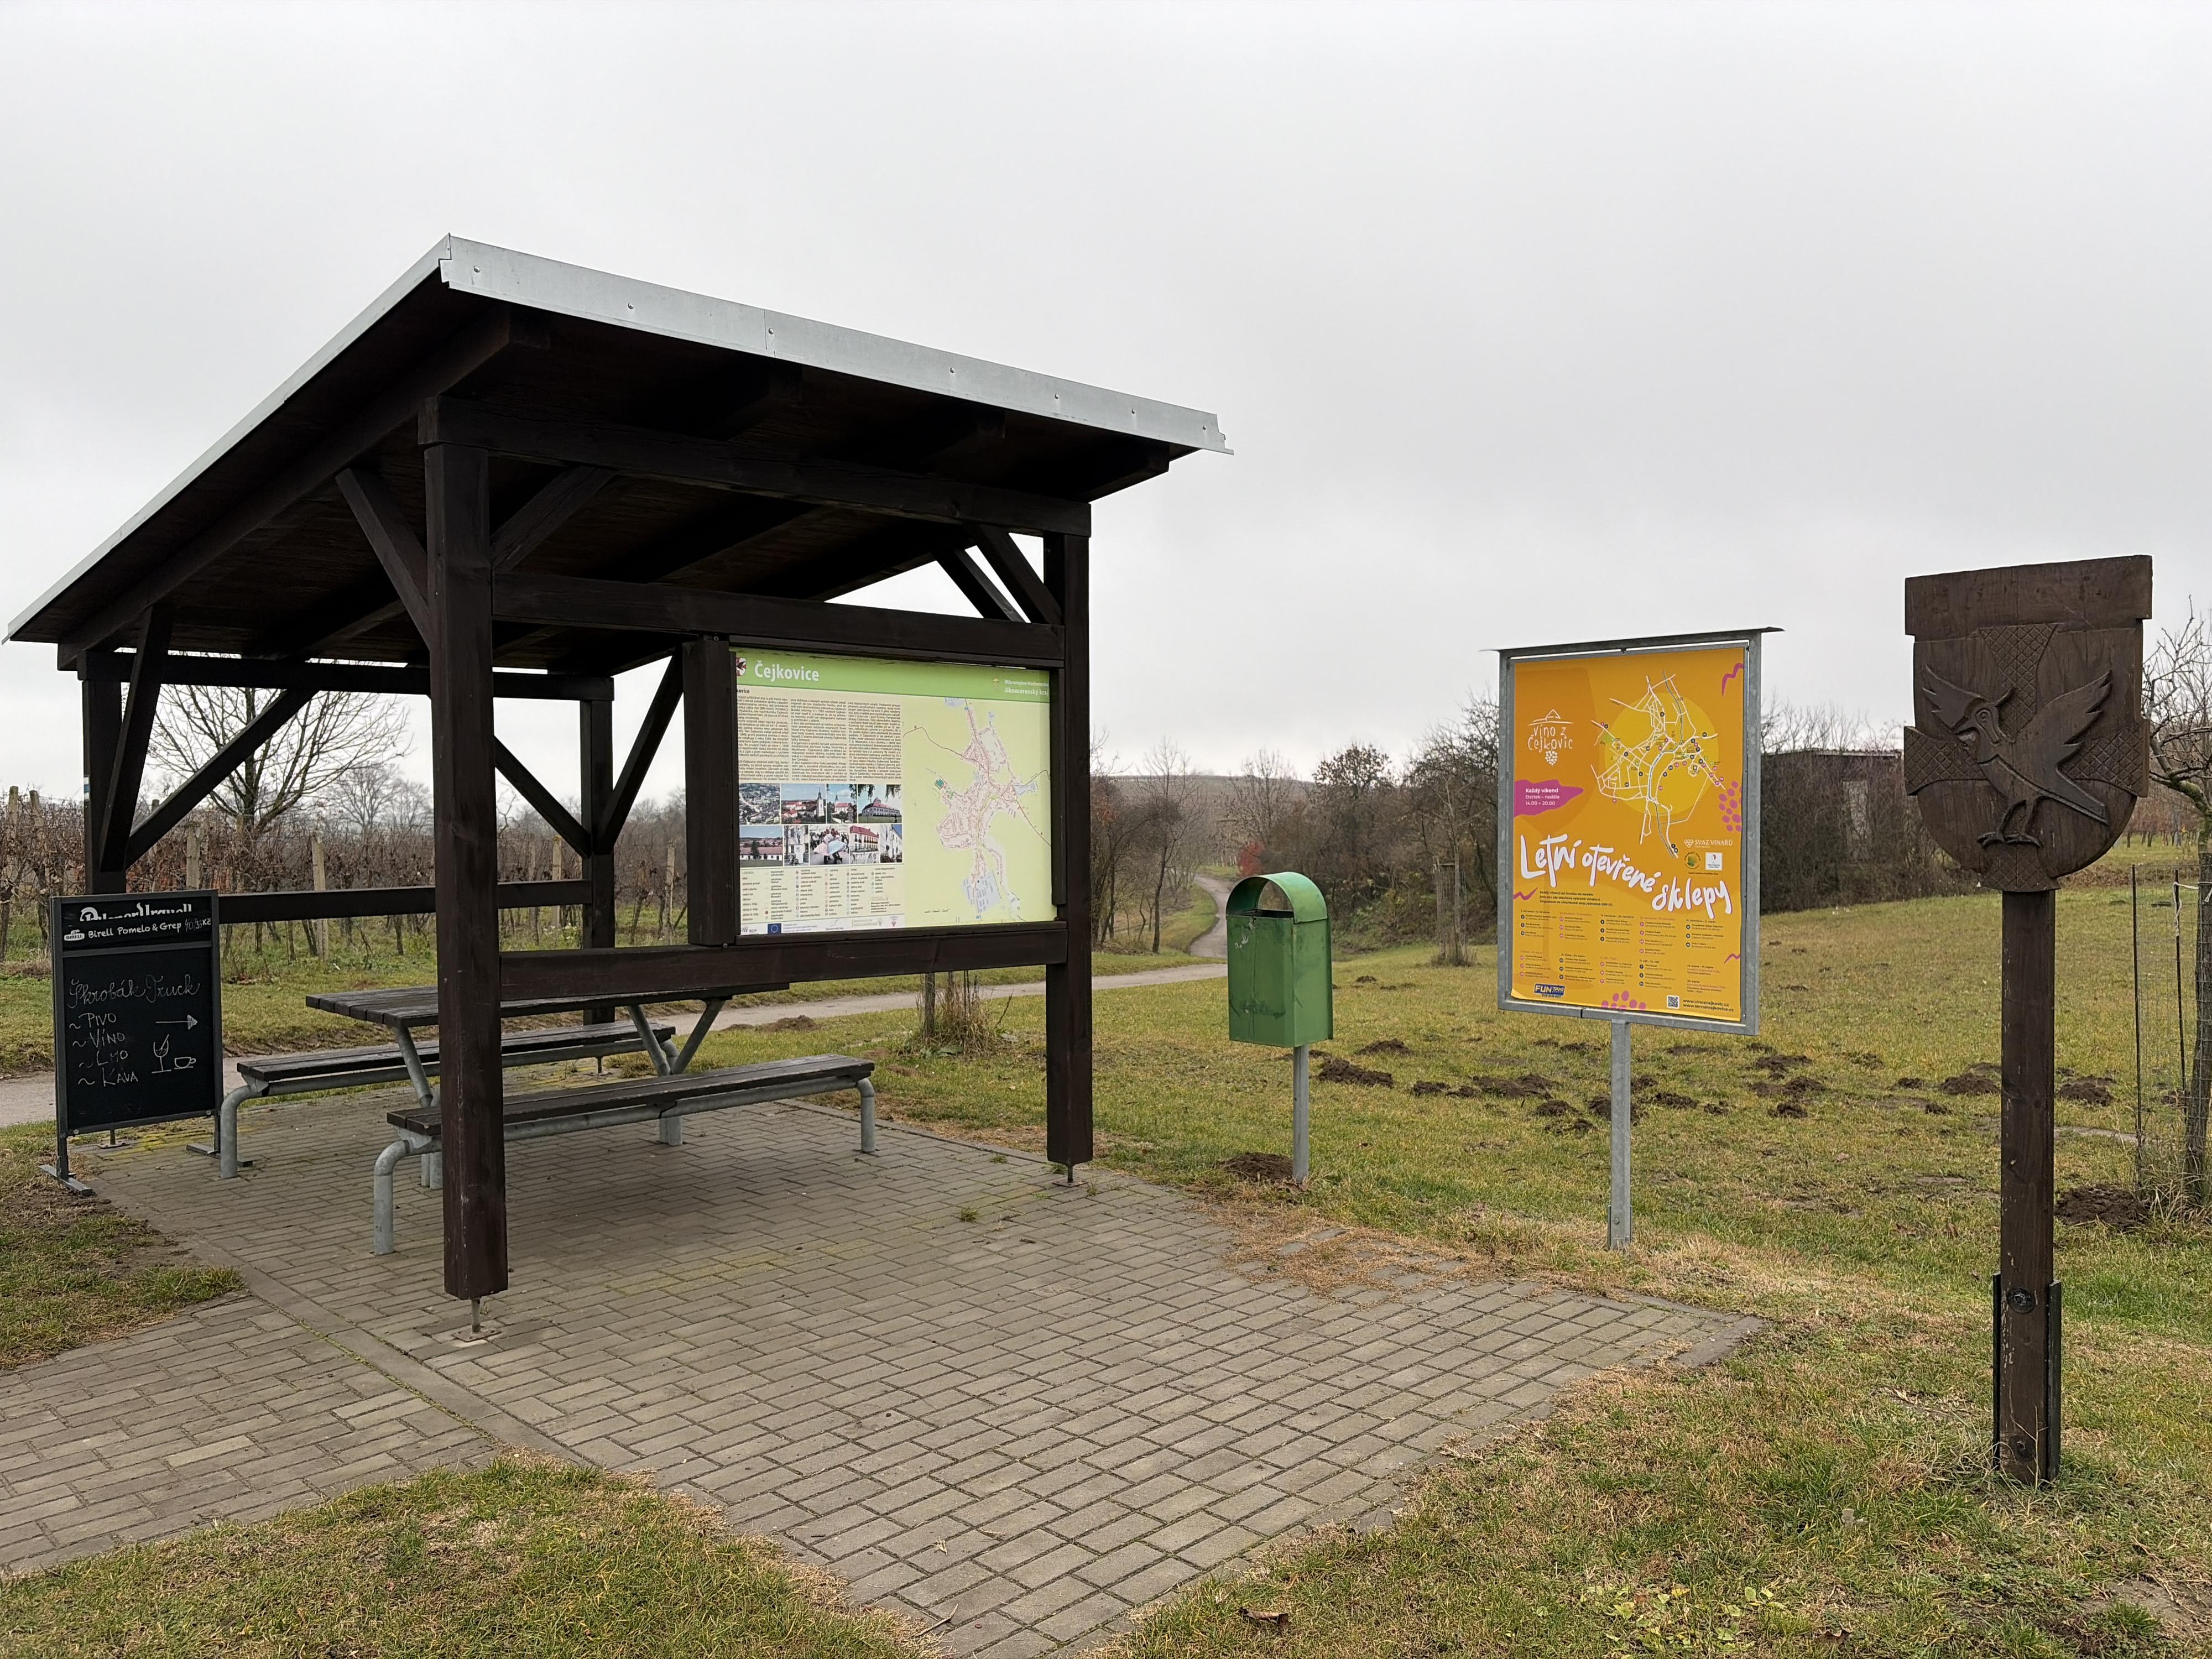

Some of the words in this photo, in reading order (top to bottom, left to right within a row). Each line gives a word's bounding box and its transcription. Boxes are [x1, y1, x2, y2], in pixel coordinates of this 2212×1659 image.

[754, 660, 820, 682] Čejkovice
[1533, 724, 1556, 737] víno
[1560, 727, 1566, 736] z
[1521, 834, 1583, 888] Letní
[1582, 843, 1662, 894] otevřené
[1651, 876, 1733, 920] sklepy
[88, 928, 114, 938] Birell
[117, 924, 150, 935] Pomelo
[152, 924, 158, 932] &
[159, 922, 182, 933] Grep
[1535, 985, 1552, 993] FUN
[79, 1013, 117, 1028] PIVO
[89, 1028, 126, 1048] VÍNO
